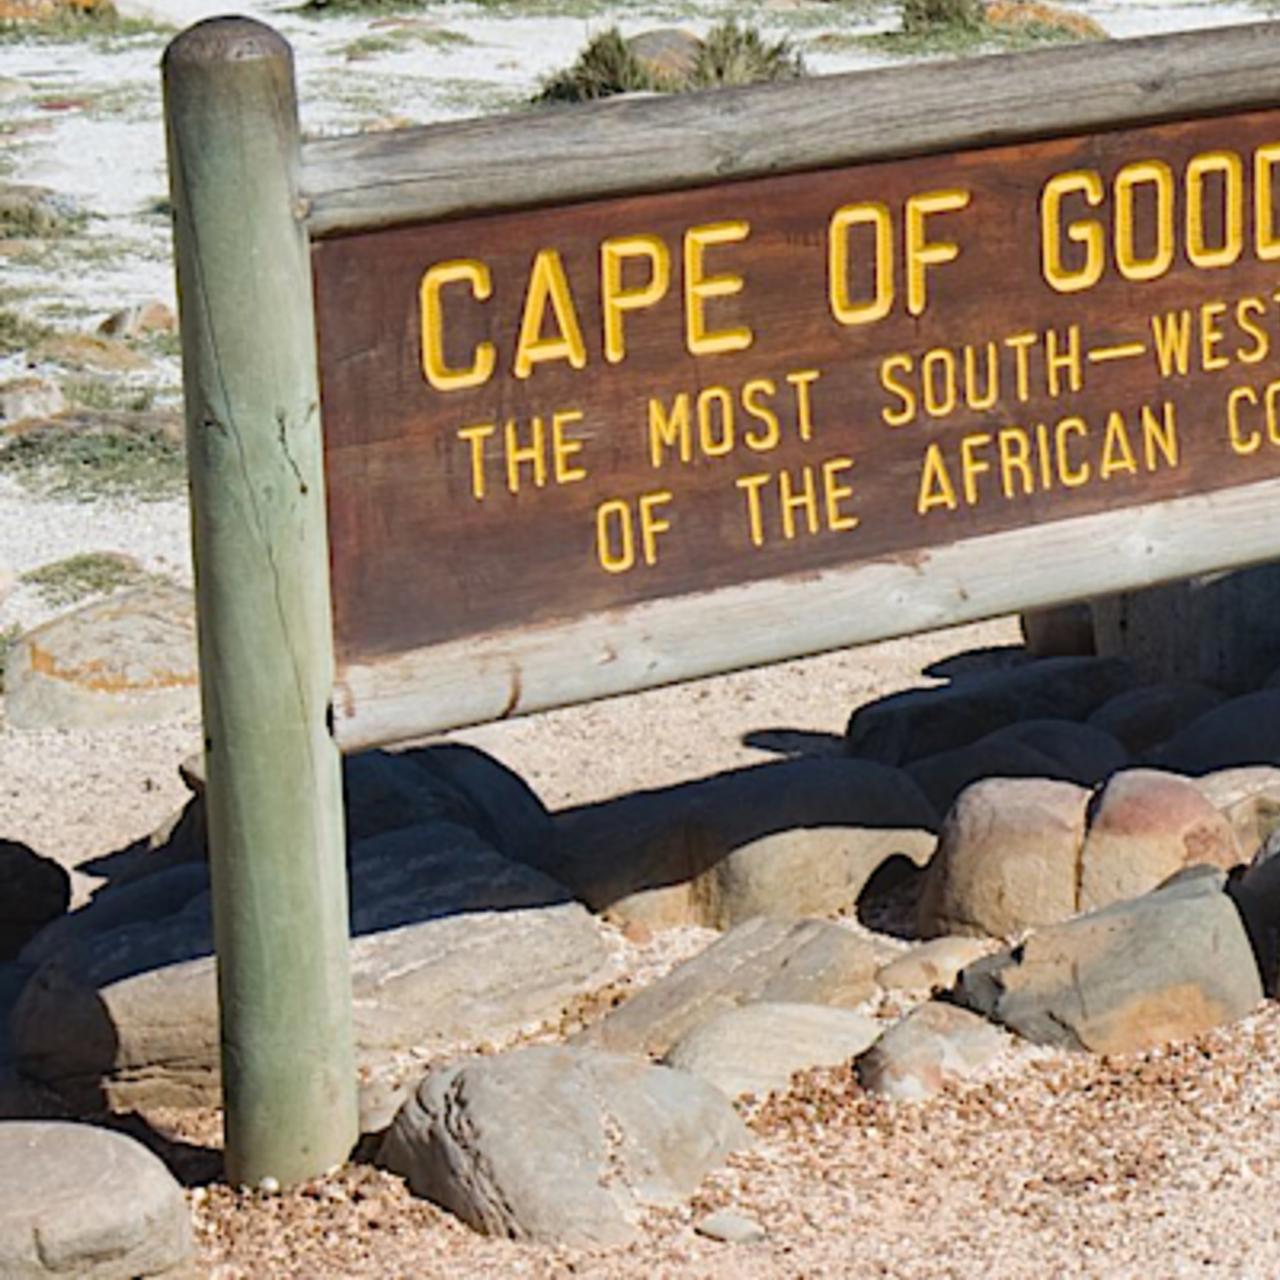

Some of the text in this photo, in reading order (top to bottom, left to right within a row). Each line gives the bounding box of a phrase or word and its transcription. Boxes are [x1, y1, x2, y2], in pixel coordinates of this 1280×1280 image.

[418, 221, 754, 393] CAPE
[827, 189, 971, 327] OF
[456, 408, 588, 500] THE
[647, 369, 821, 470] MOST
[595, 490, 674, 575] OF
[735, 457, 859, 547] THE
[916, 400, 1179, 514] AFRICAN
